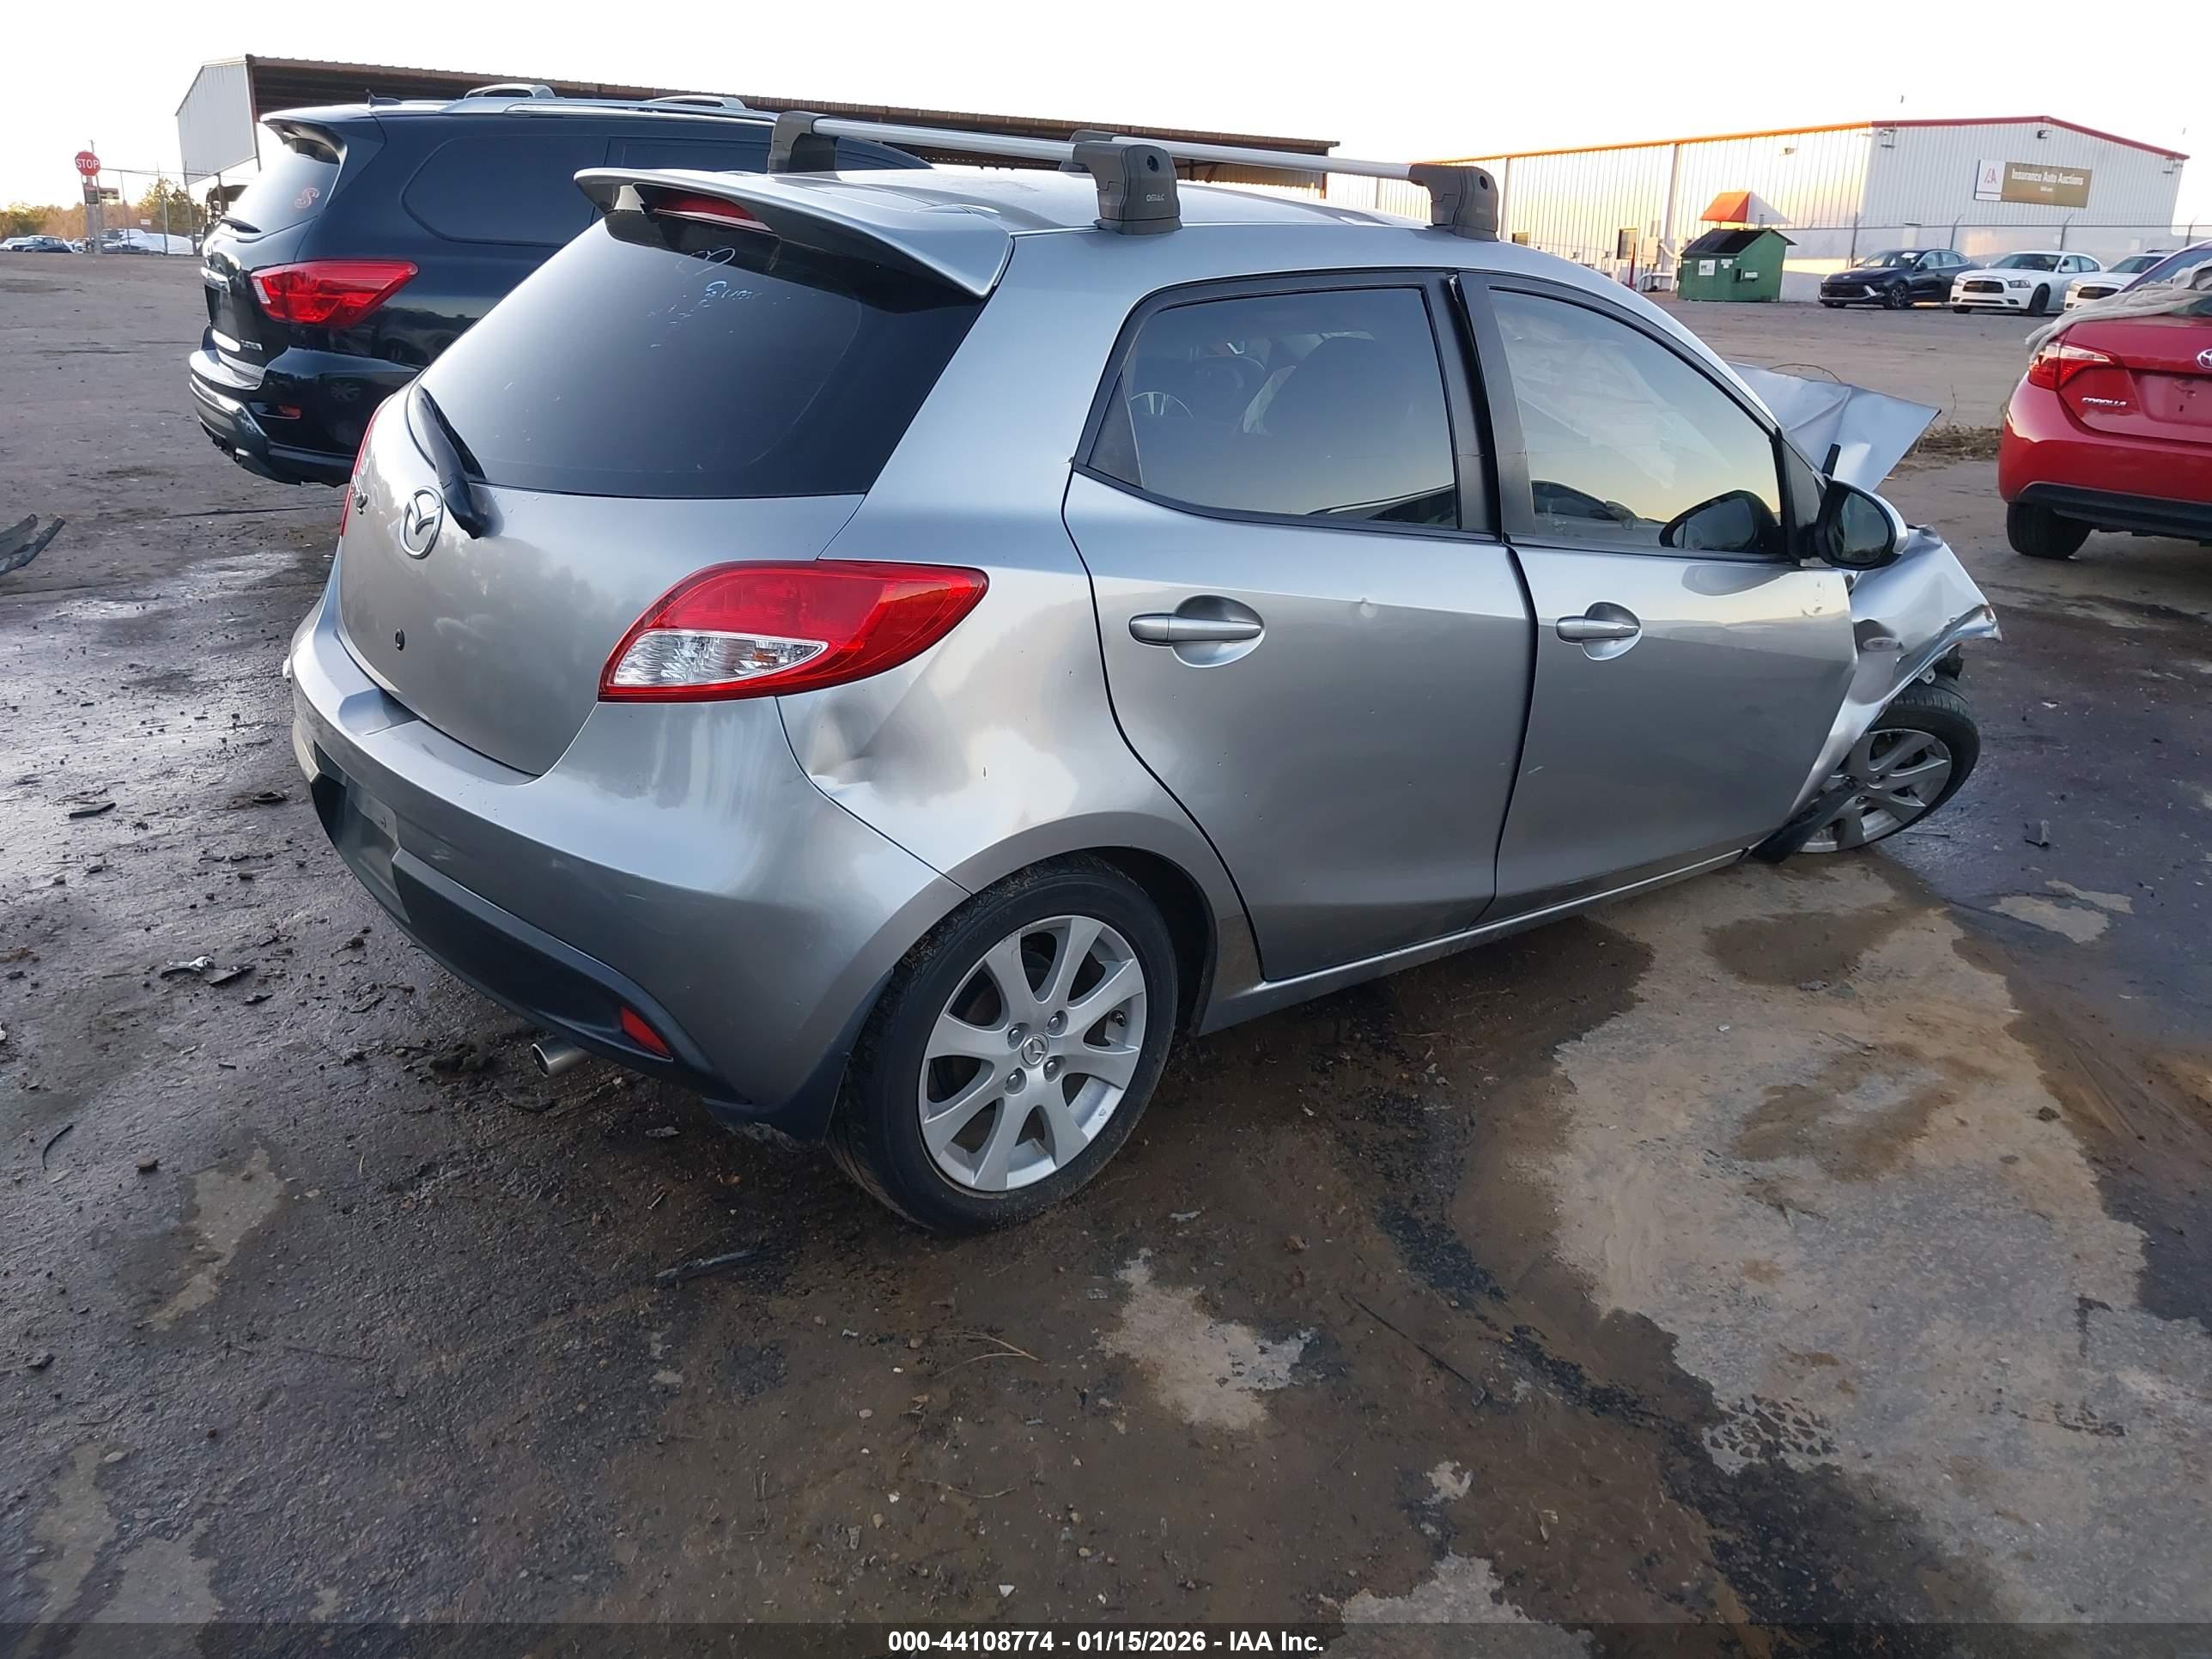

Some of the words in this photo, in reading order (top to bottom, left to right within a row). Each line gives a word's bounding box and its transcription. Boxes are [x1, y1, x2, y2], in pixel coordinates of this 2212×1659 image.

[76, 158, 100, 170] STOP
[2011, 168, 2042, 182] Insurance
[2042, 171, 2057, 184] Auto
[2057, 172, 2084, 185] Auctions
[2081, 397, 2127, 407] COROLLA
